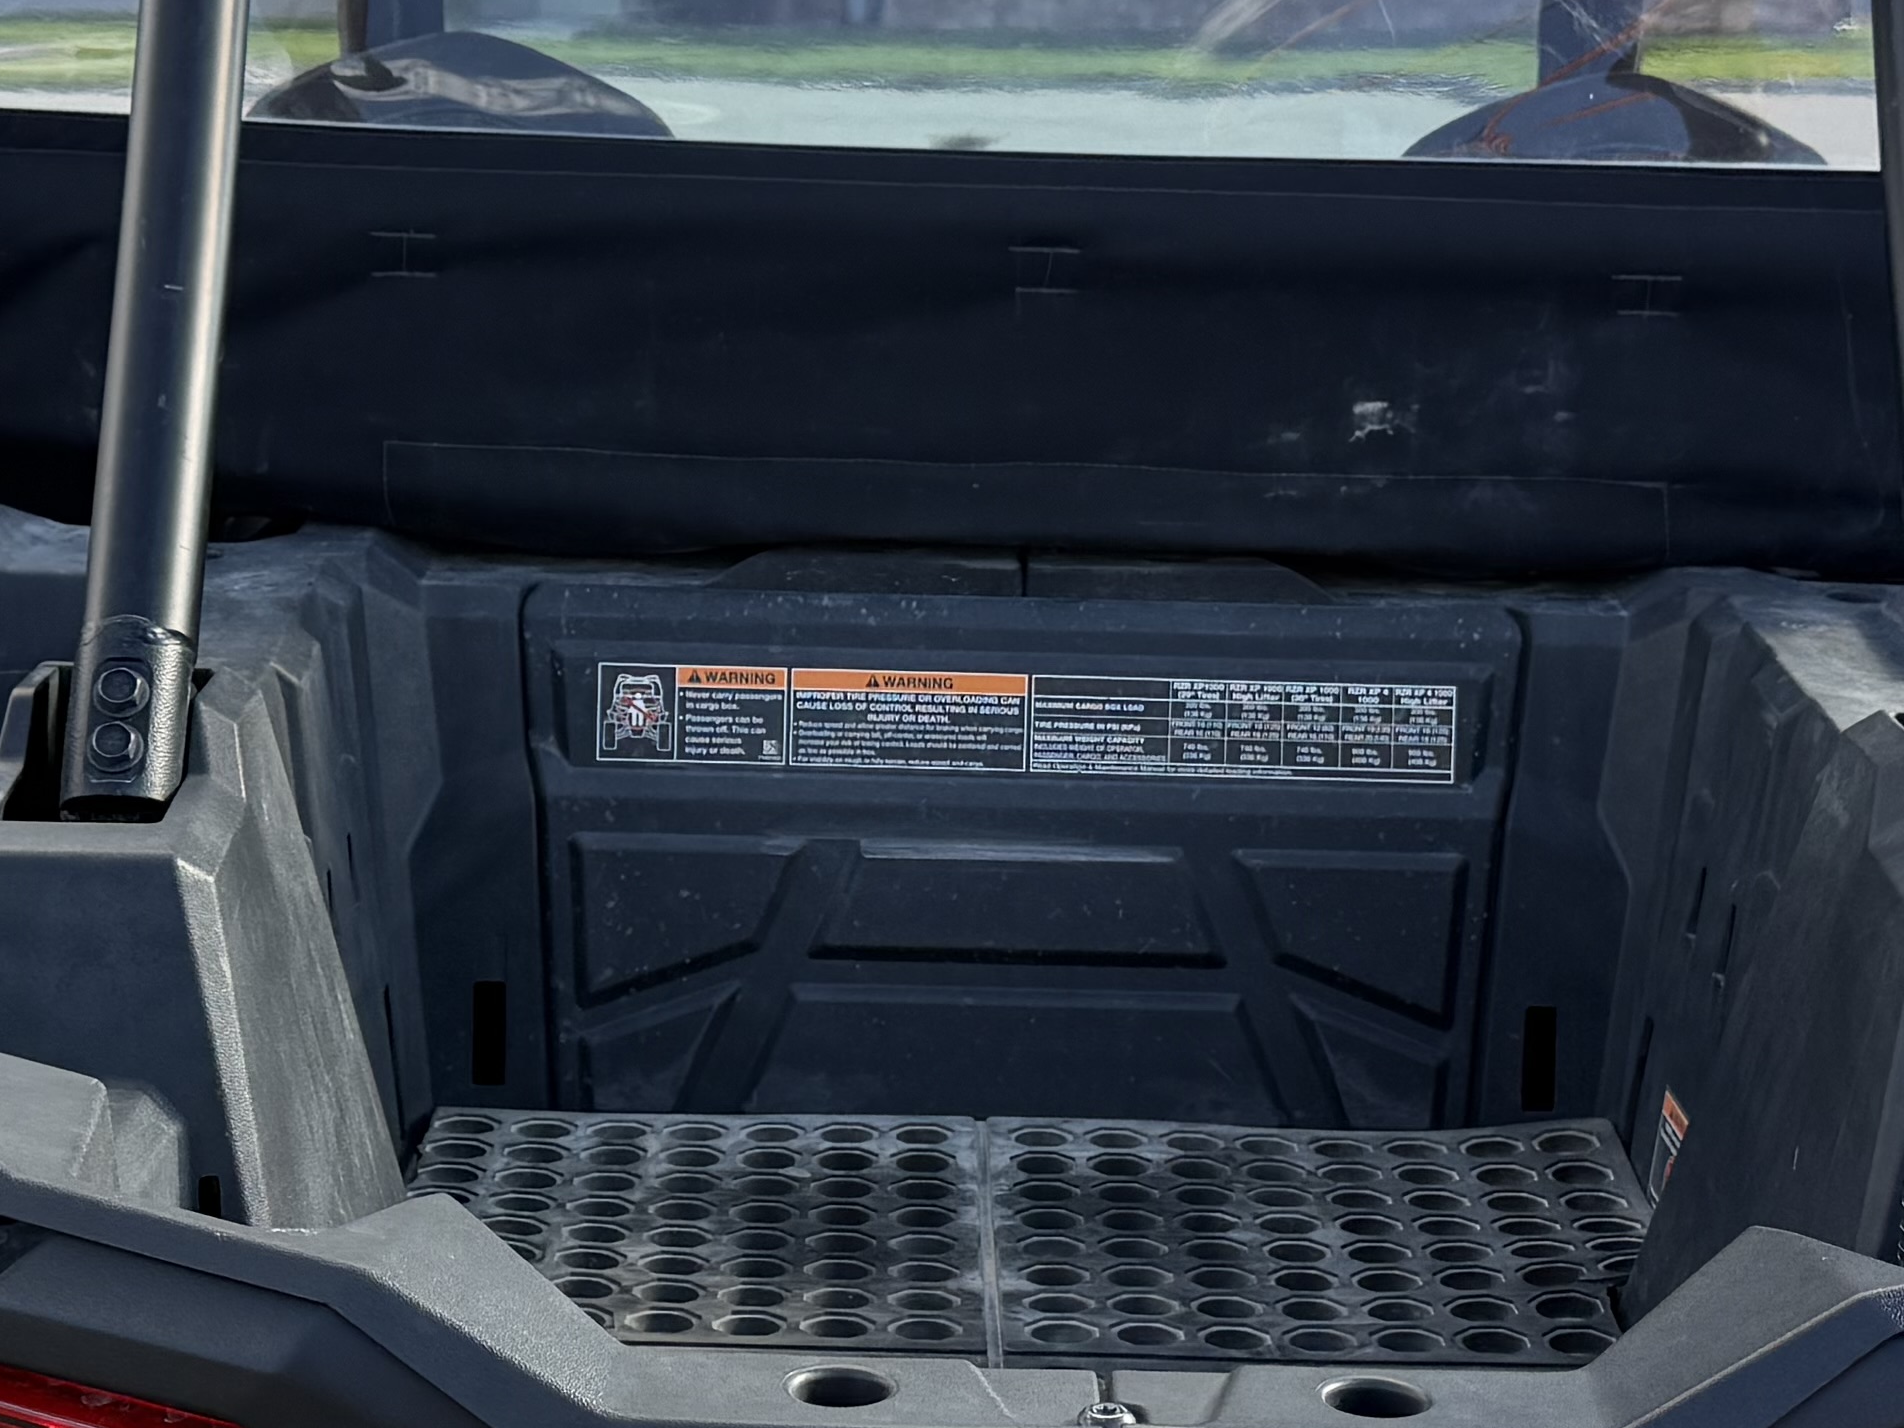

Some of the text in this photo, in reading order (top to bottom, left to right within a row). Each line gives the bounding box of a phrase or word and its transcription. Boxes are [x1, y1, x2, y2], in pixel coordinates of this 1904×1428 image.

[705, 671, 776, 685] WARNING
[882, 675, 954, 690] WARNING
[685, 690, 783, 702] Never carry passengers
[796, 691, 1021, 706] IMPROPER TIRE PRESSURE OR OVERLOADING CAN
[696, 703, 720, 711] cargo
[796, 701, 1020, 715] CAUSE LOSS OF CONTROL RESULTING IN SERIOUS
[1075, 702, 1103, 710] CARGO
[1123, 704, 1145, 712] LOAD
[685, 714, 733, 724] Passengers
[752, 716, 764, 724] be
[867, 713, 951, 724] INJURY OR DEATH.
[732, 725, 749, 734] This
[1035, 721, 1052, 729] TIRE
[1054, 721, 1095, 730] PRESSURE
[712, 737, 742, 745] serious
[685, 746, 707, 755] injury
